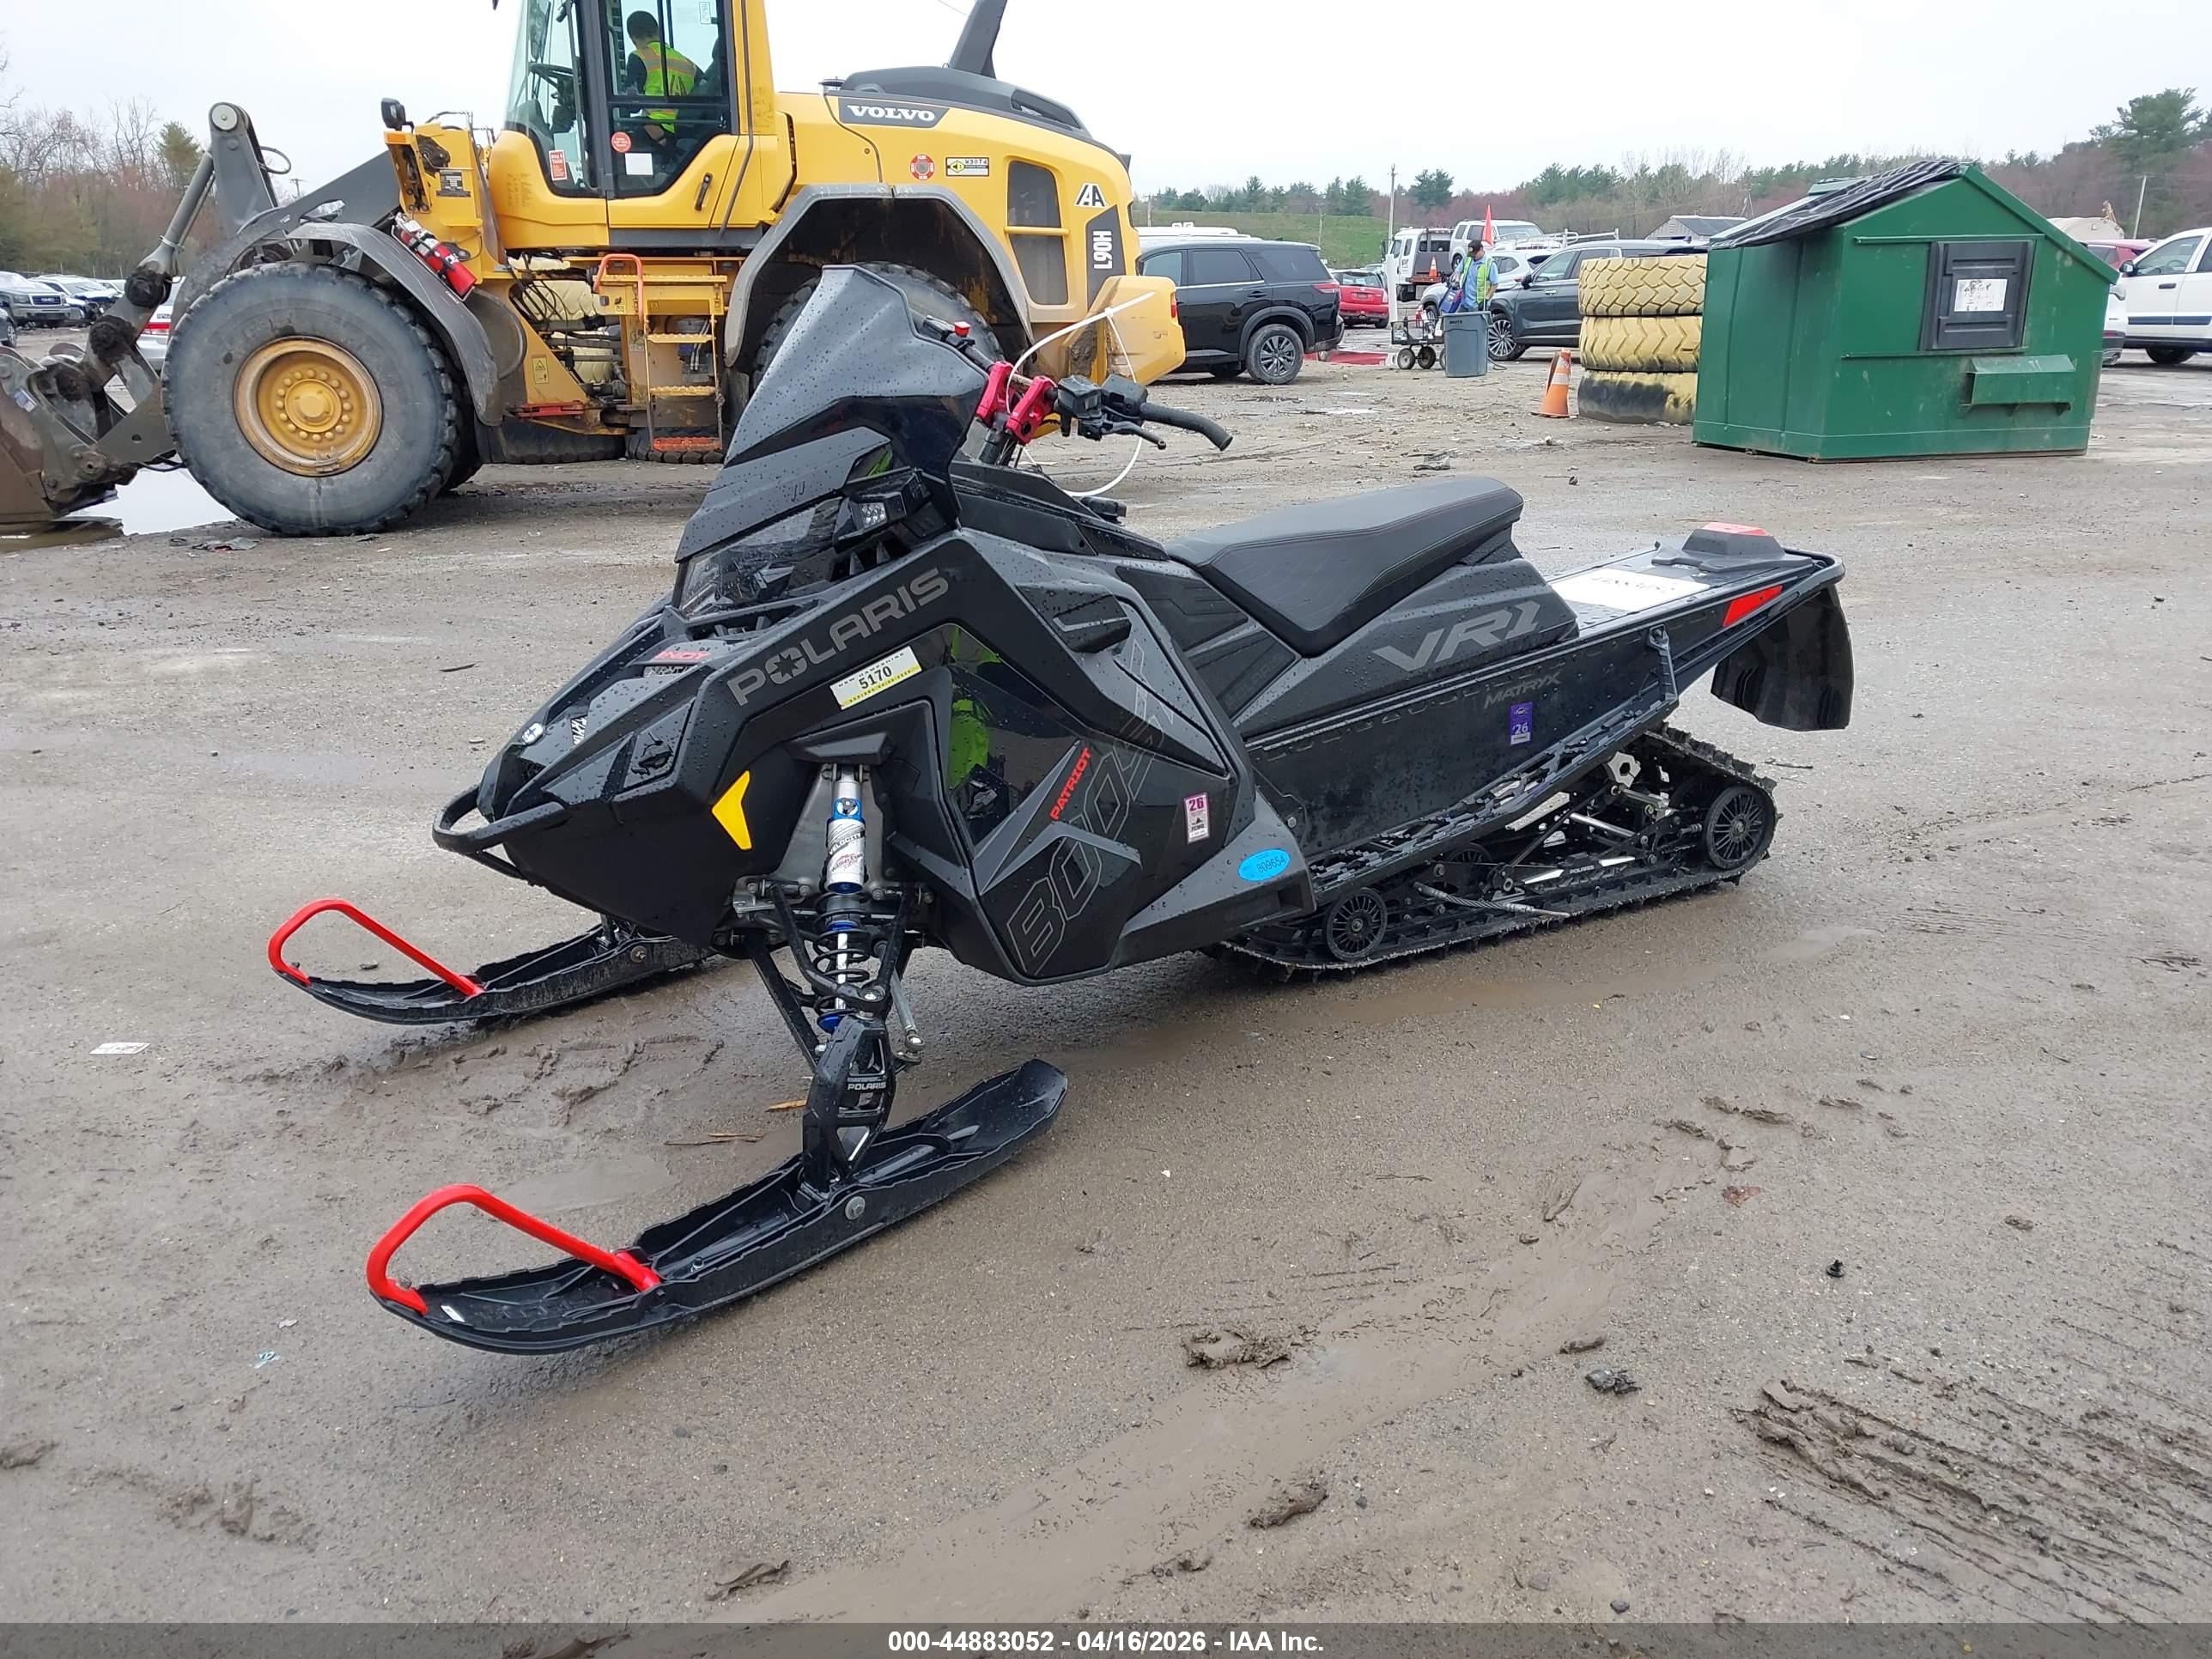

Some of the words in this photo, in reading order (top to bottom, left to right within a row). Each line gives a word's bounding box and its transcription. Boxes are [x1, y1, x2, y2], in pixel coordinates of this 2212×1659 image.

[847, 105, 935, 121] VOLVO
[1092, 230, 1113, 270] L90H
[727, 568, 949, 707] POLARIS
[1372, 600, 1540, 672] VR1
[858, 665, 892, 689] 5170
[1484, 672, 1561, 709] MATRYX
[1050, 747, 1091, 820] PATRIOT
[1188, 797, 1204, 811] 26
[830, 832, 861, 855] VELOCITY
[847, 1081, 887, 1091] POLARIS
